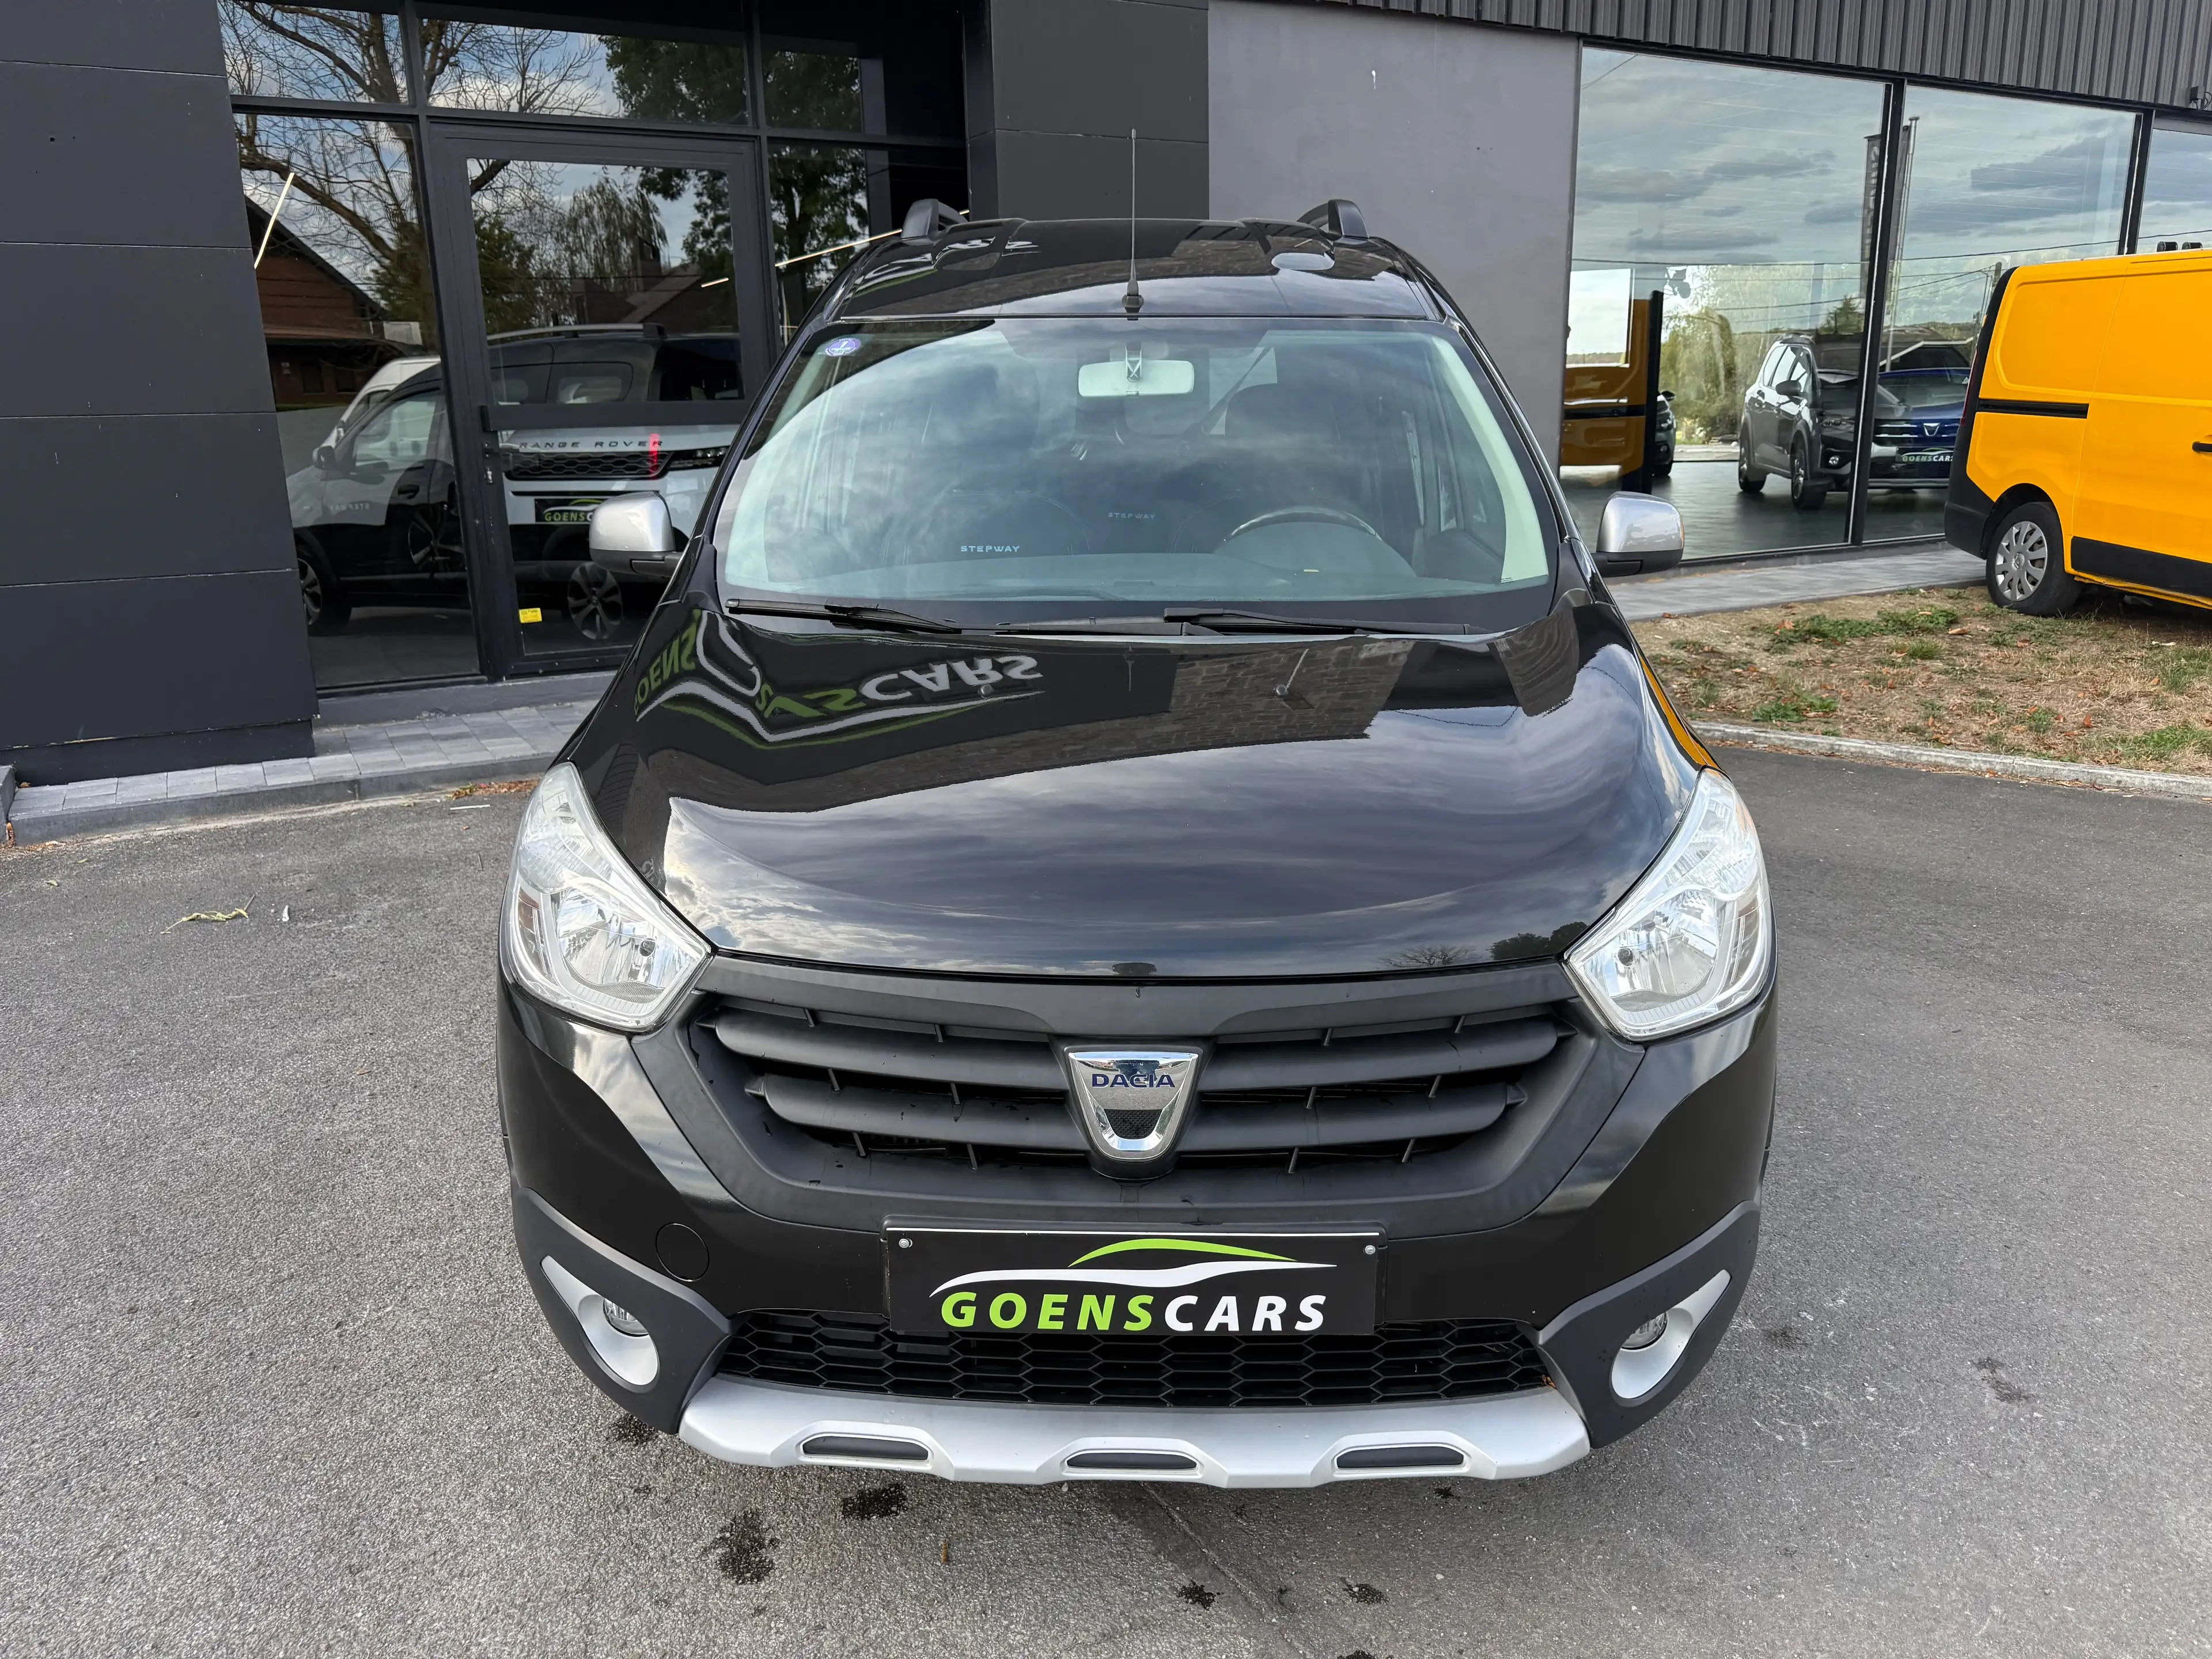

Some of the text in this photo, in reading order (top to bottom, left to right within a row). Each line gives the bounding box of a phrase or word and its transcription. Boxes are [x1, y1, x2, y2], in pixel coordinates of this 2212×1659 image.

[544, 512, 593, 521] GOENSC
[1092, 1073, 1176, 1088] DACIA
[941, 1291, 1327, 1331] GOENSCARS
